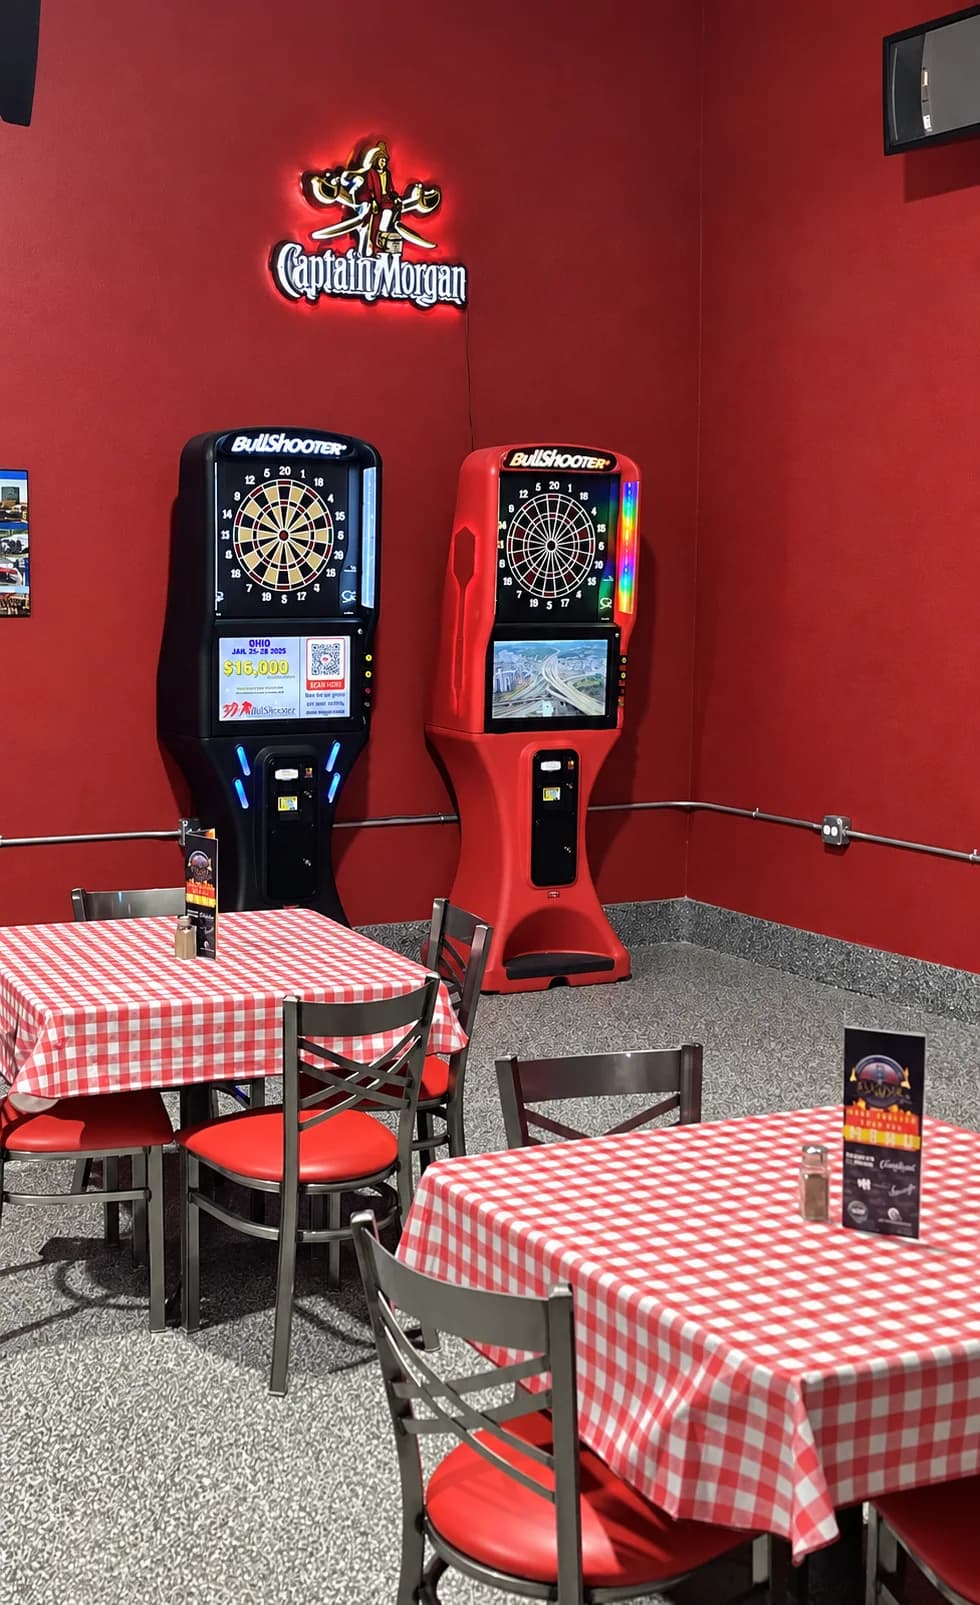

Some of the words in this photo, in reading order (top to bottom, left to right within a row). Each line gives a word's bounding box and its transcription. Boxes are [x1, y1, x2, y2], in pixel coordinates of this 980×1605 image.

[277, 243, 377, 300] Captain
[366, 253, 466, 307] Morgan
[279, 466, 291, 475] 20
[301, 469, 305, 478] 1
[245, 475, 255, 484] 12
[314, 478, 323, 487] 18
[549, 481, 559, 490] 20
[568, 484, 571, 492] 1
[328, 494, 333, 503] 4
[520, 490, 528, 498] 12
[591, 507, 597, 516] 4
[246, 584, 252, 592] 7
[297, 592, 306, 600] 17
[517, 590, 522, 598] 7
[561, 599, 569, 607] 17
[249, 639, 271, 648] OHIO
